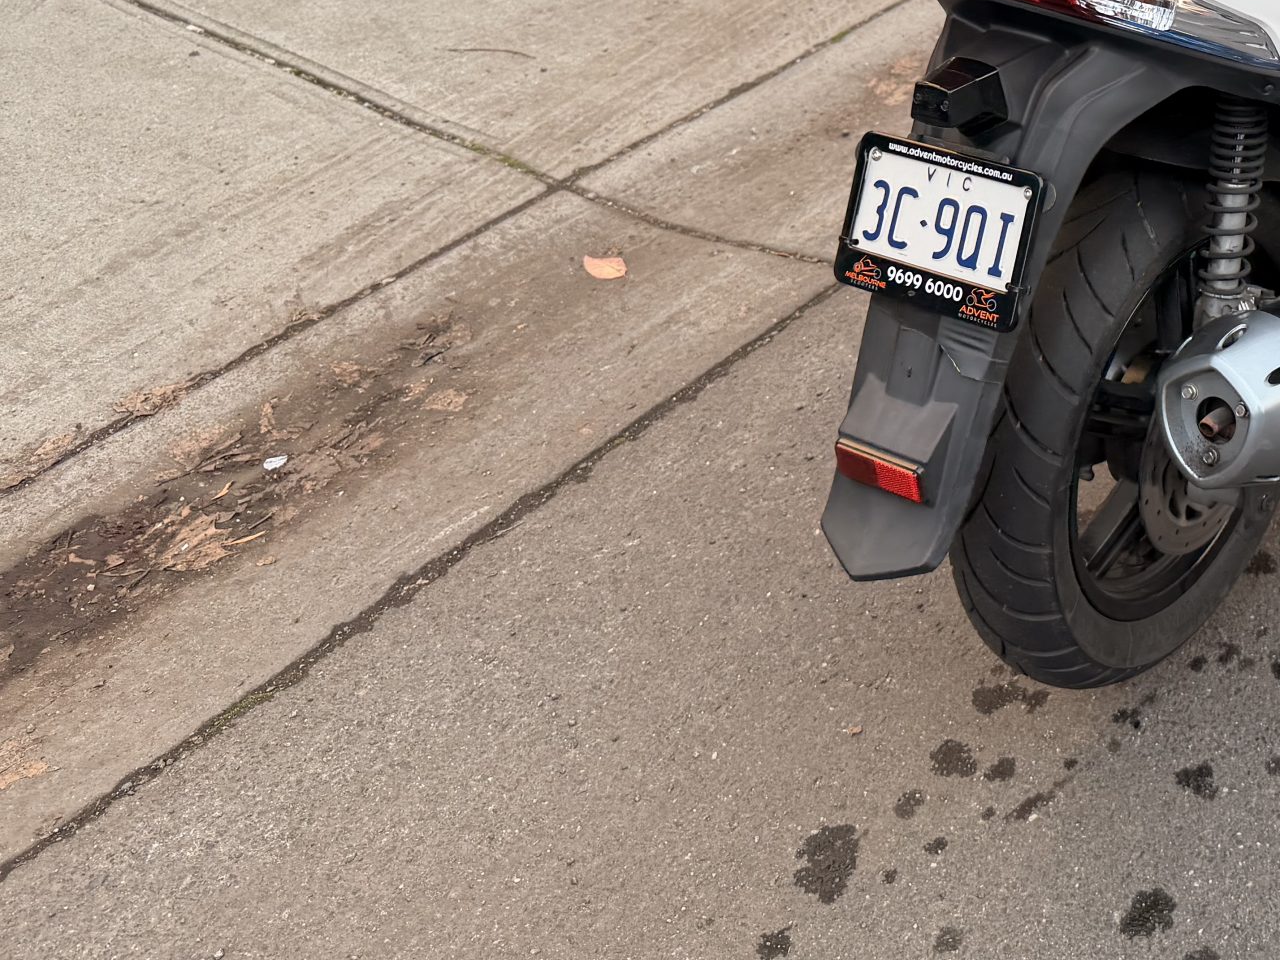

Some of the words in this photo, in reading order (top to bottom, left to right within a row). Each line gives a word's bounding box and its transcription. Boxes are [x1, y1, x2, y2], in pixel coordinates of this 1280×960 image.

[888, 141, 1014, 182] www.adventmotorcycles.com.au
[844, 270, 888, 289] MELBOURNE
[886, 265, 923, 290] 9699
[925, 278, 964, 302] 6000
[957, 312, 998, 328] MOTORCYCLES
[959, 304, 1000, 323] ADVENT
